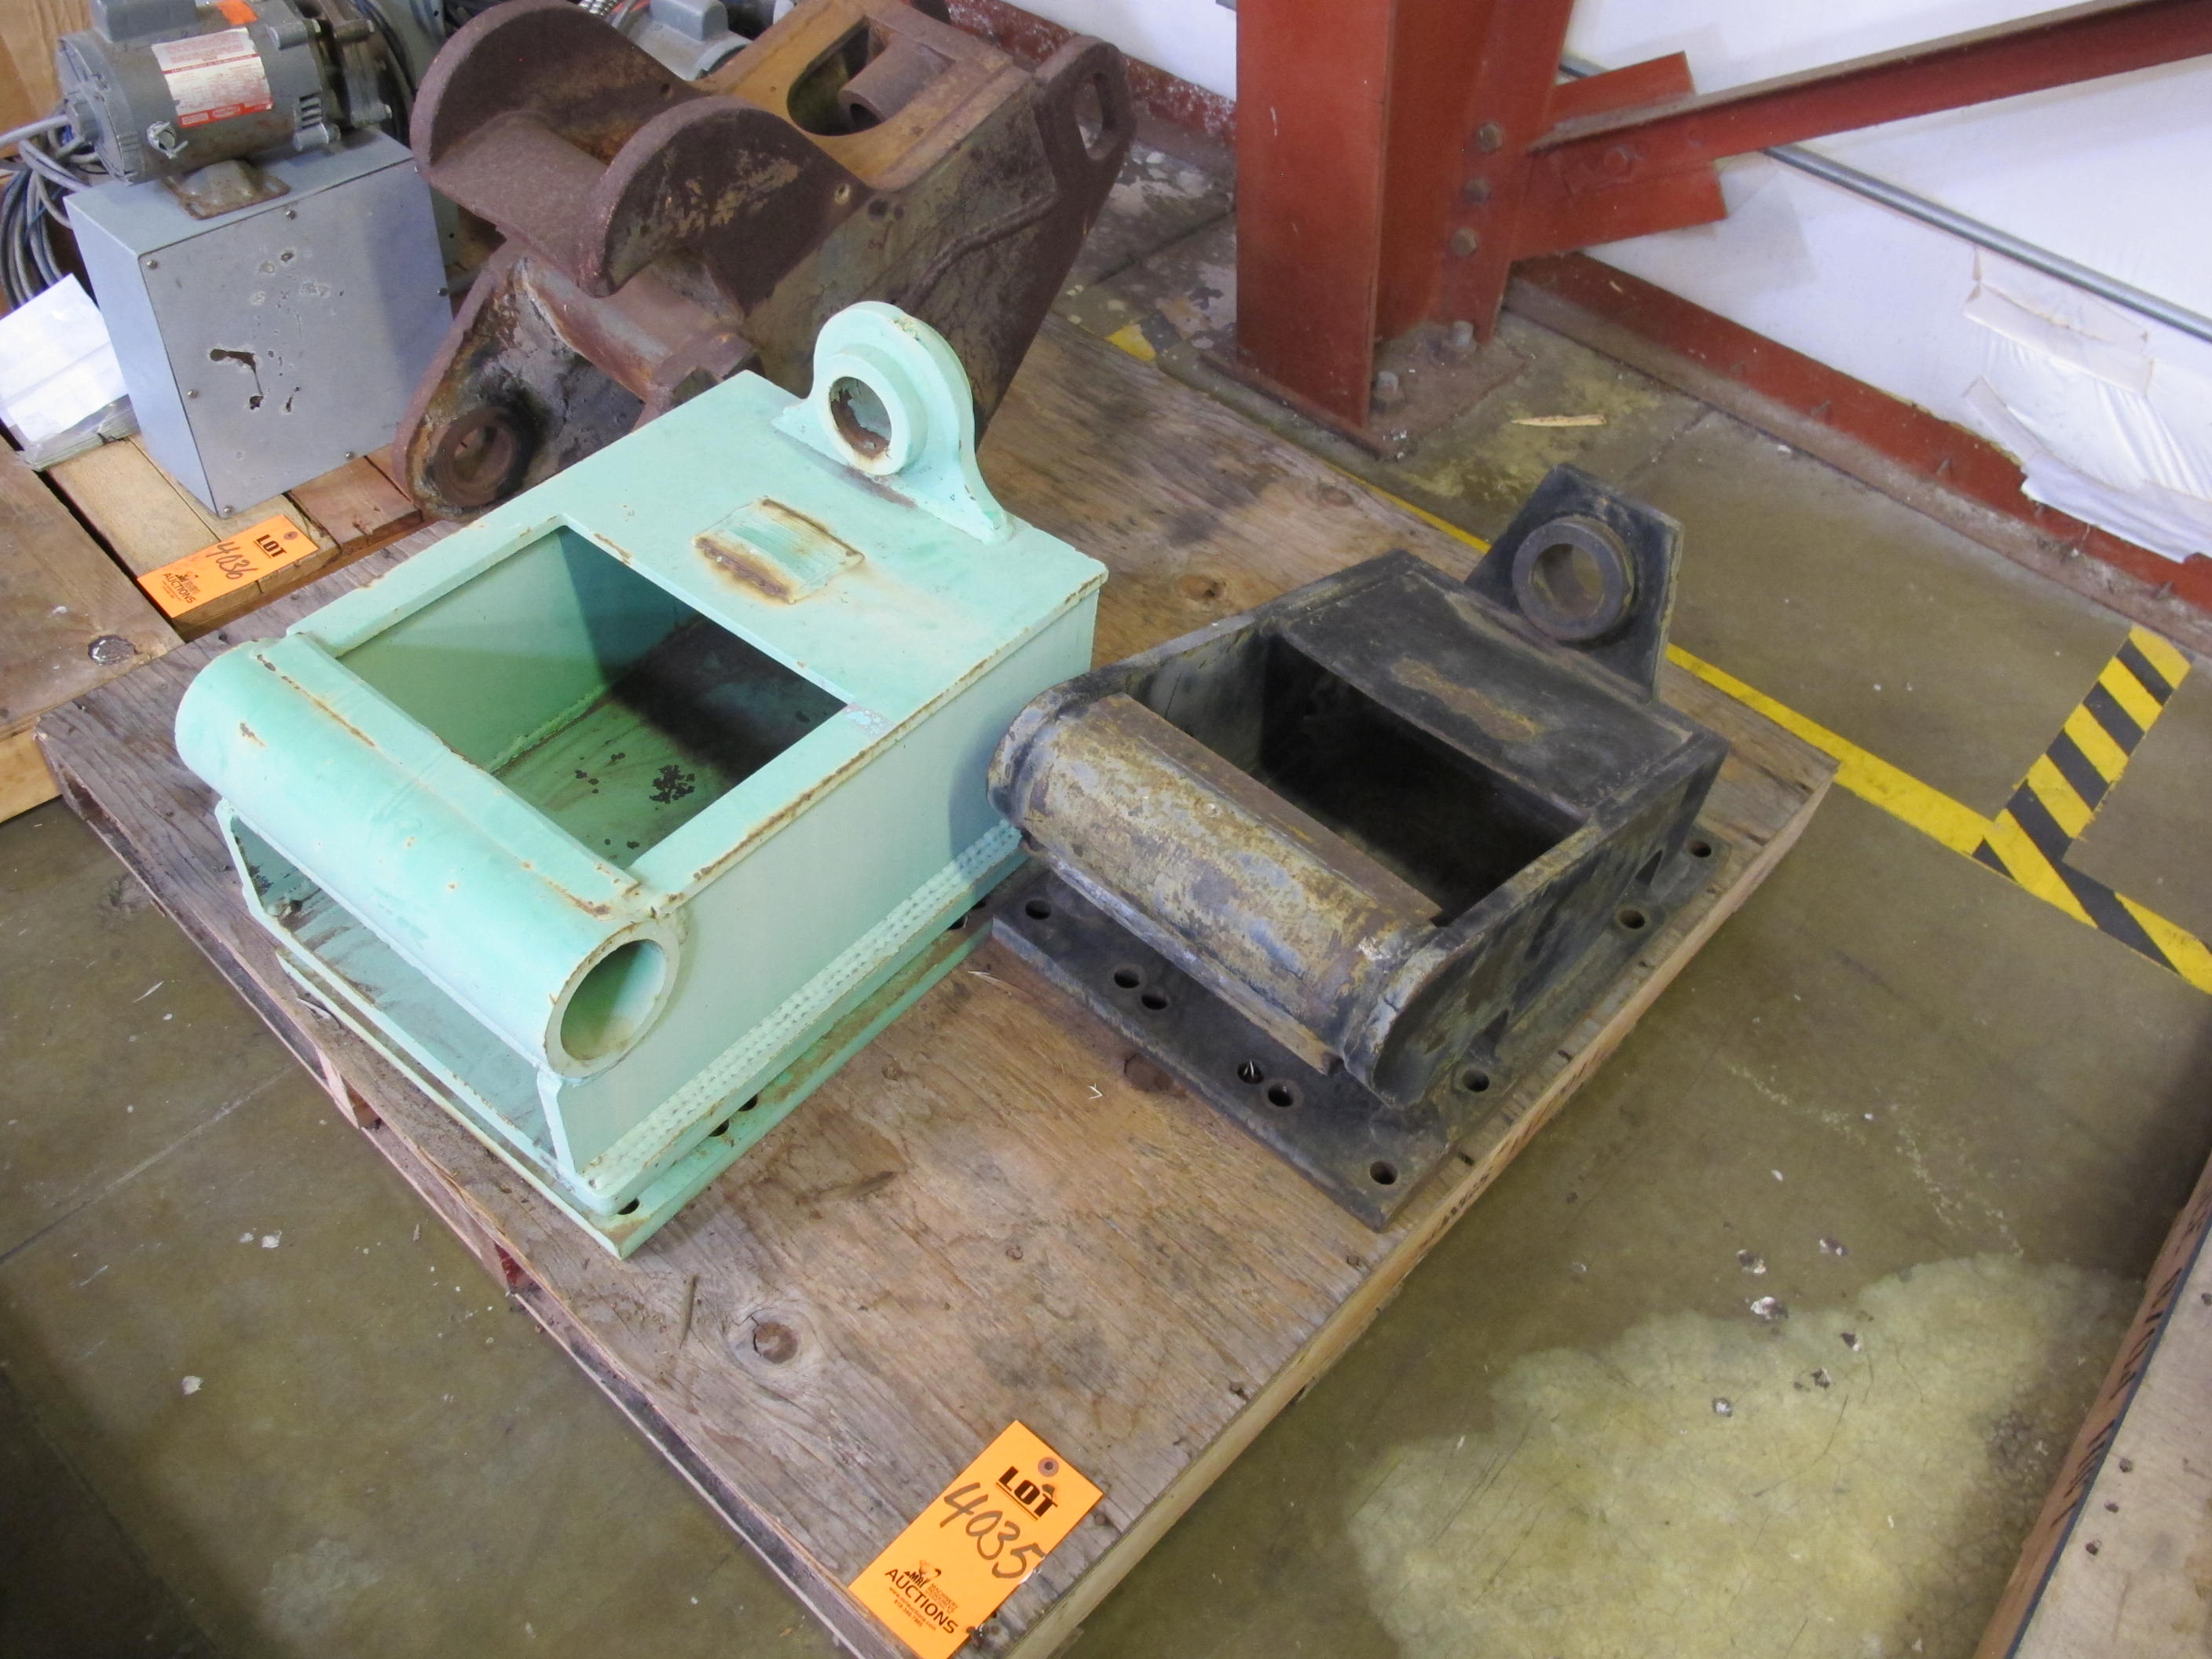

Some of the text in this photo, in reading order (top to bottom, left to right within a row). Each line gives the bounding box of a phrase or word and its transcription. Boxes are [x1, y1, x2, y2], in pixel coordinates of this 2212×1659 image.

[206, 541, 258, 580] 4036
[256, 534, 287, 558] LOT
[163, 573, 196, 603] AUCTIONS
[998, 1466, 1058, 1518] LOT
[939, 1482, 1046, 1579] 4035
[884, 1569, 958, 1634] AUCTIONS
